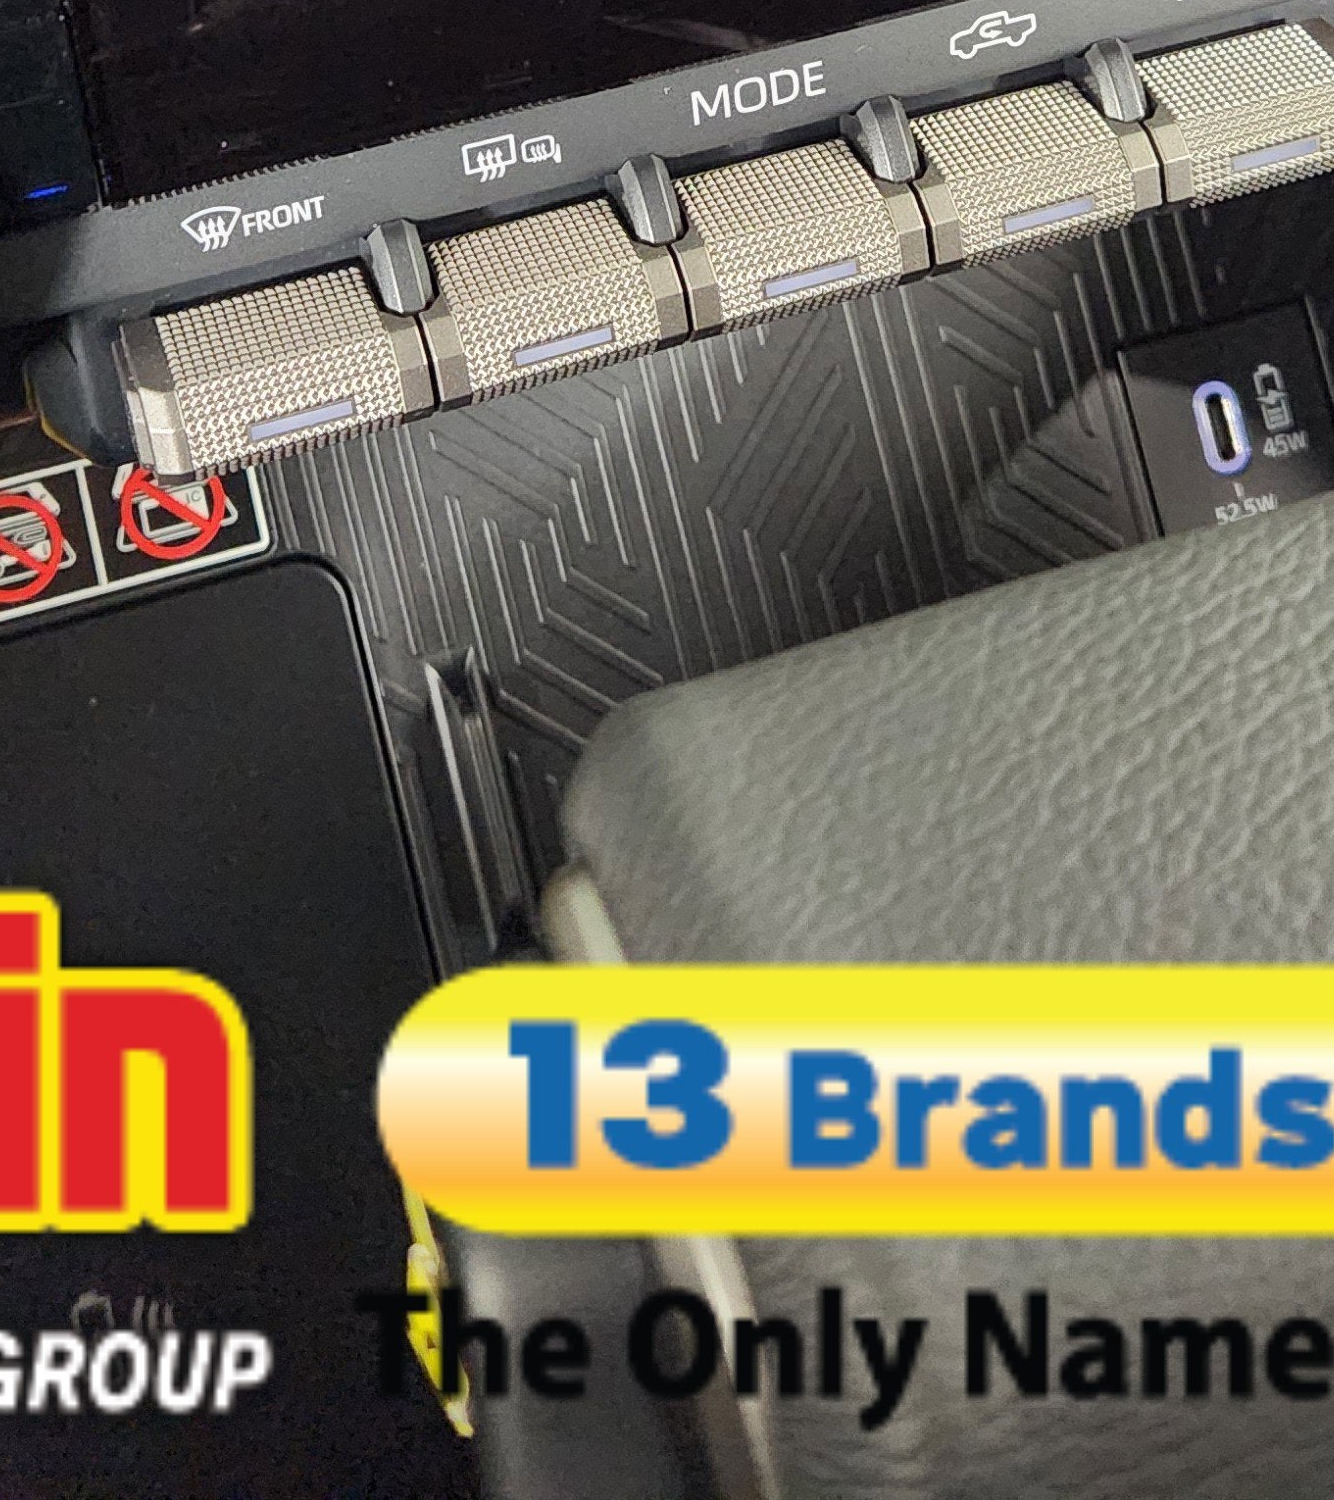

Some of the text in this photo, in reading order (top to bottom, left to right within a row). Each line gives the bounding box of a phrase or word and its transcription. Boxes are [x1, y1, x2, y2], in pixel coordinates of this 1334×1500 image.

[691, 60, 827, 127] MODE
[241, 194, 325, 237] FRONT
[1262, 430, 1309, 458] 45W
[1214, 492, 1278, 526] 52.5W
